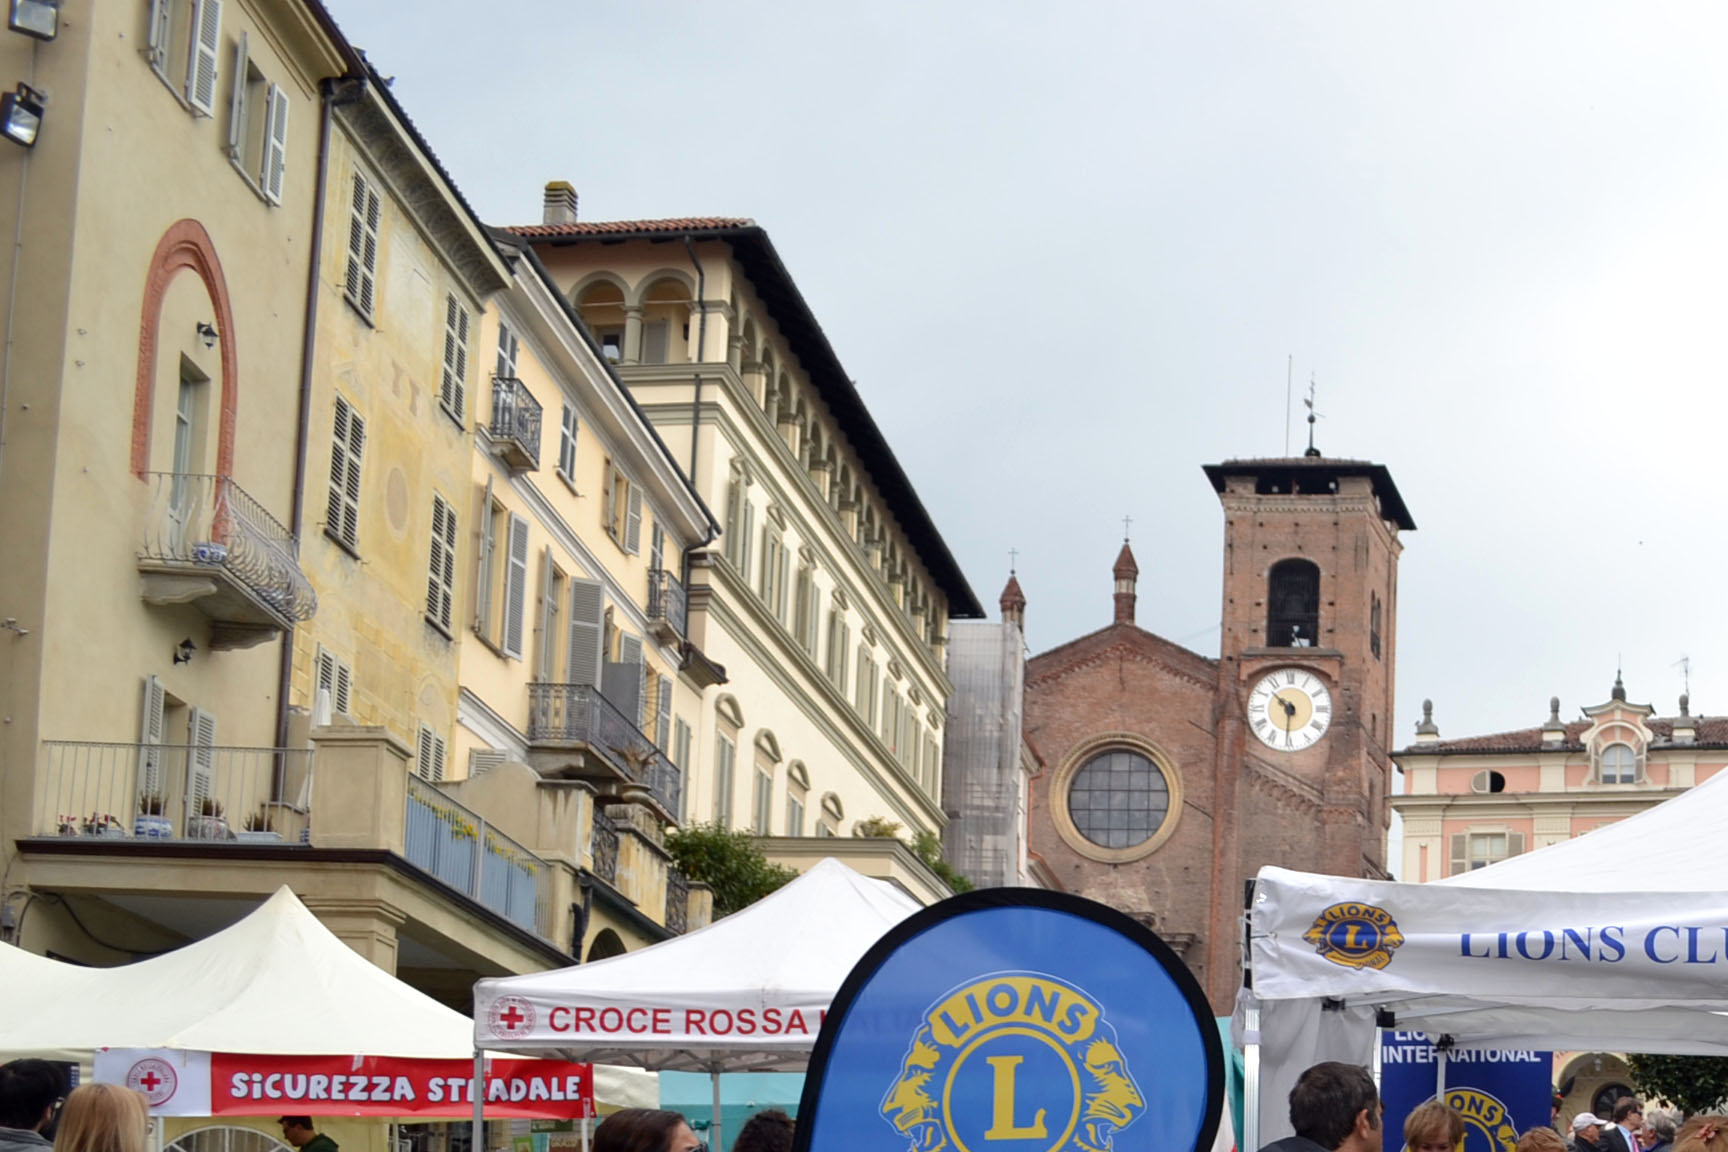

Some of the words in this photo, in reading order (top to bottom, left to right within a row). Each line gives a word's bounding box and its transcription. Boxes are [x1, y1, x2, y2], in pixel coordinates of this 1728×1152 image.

[1329, 906, 1386, 922] LIONS
[1344, 925, 1368, 948] L
[1460, 926, 1627, 962] LIONS
[549, 1006, 672, 1034] CROCE
[684, 1008, 809, 1035] ROSSA
[939, 983, 1088, 1039] LIONS
[984, 1055, 1047, 1141] L
[1450, 1095, 1498, 1122] ONS
